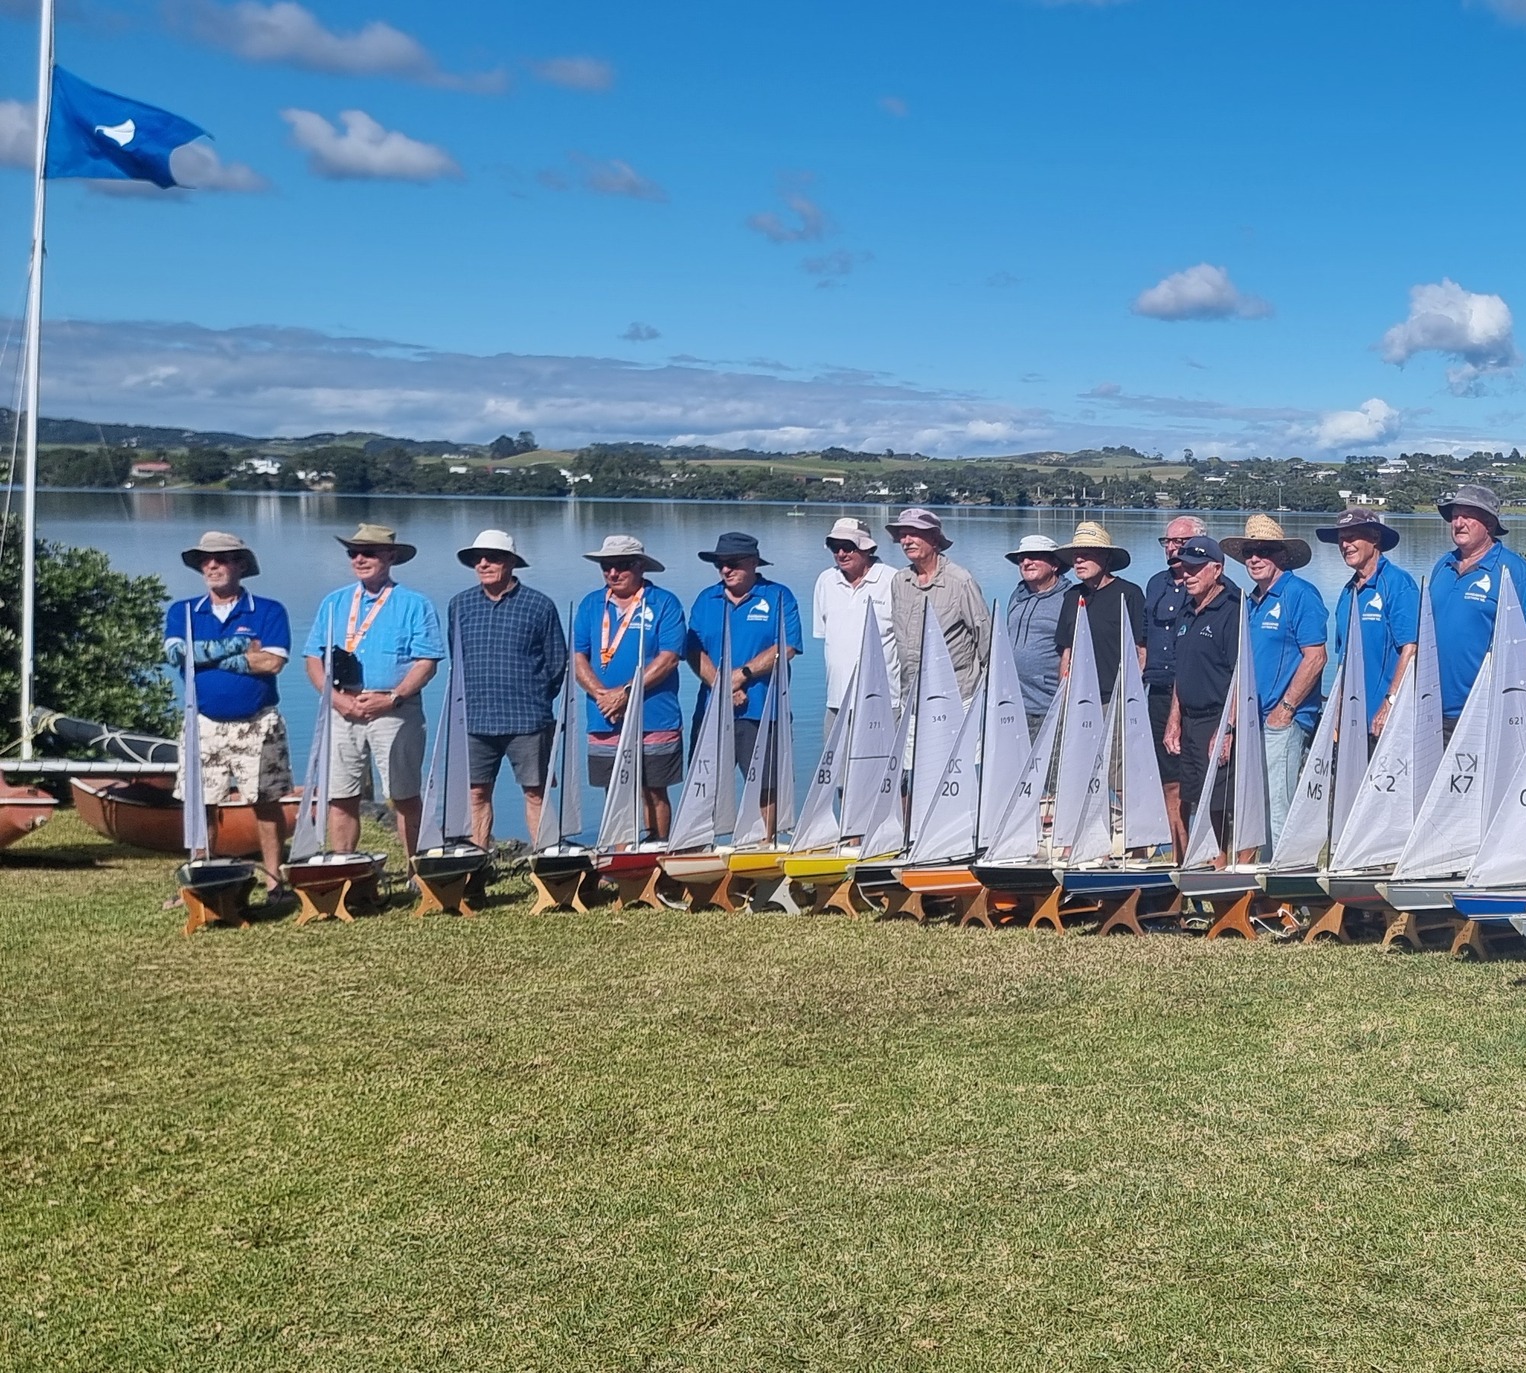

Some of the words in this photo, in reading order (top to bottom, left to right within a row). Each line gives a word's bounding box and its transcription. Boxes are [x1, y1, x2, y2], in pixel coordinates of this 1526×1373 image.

[932, 714, 947, 723] 349
[1508, 716, 1524, 726] 621
[817, 769, 831, 785] B3
[1450, 774, 1473, 793] K7
[694, 782, 706, 798] 71
[941, 781, 959, 797] 20
[1019, 781, 1032, 798] 74
[1306, 781, 1322, 800] M5
